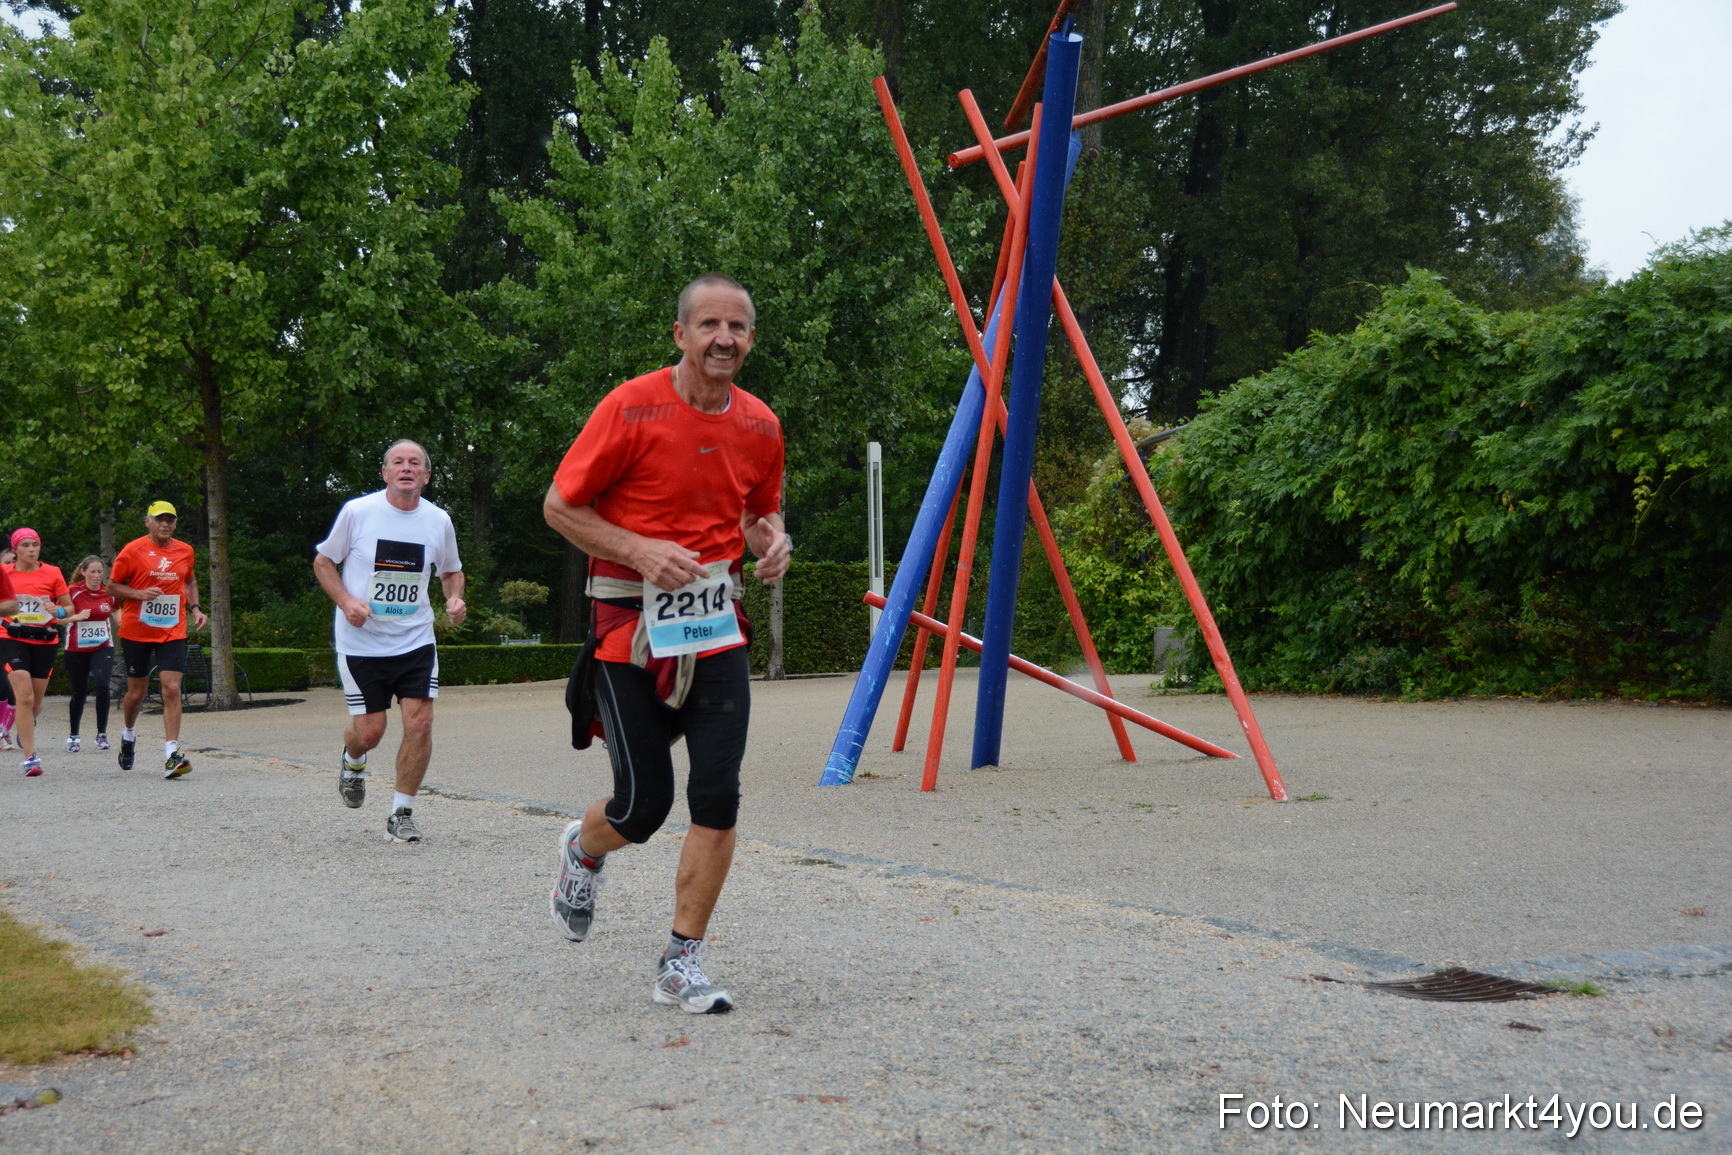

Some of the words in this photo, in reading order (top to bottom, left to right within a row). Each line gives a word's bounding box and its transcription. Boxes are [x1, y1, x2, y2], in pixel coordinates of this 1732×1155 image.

[374, 583, 419, 602] 2808
[655, 582, 726, 621] 2214
[146, 602, 177, 616] 3085
[385, 606, 404, 615] Alois
[81, 627, 106, 638] 2345
[683, 625, 713, 640] Peter
